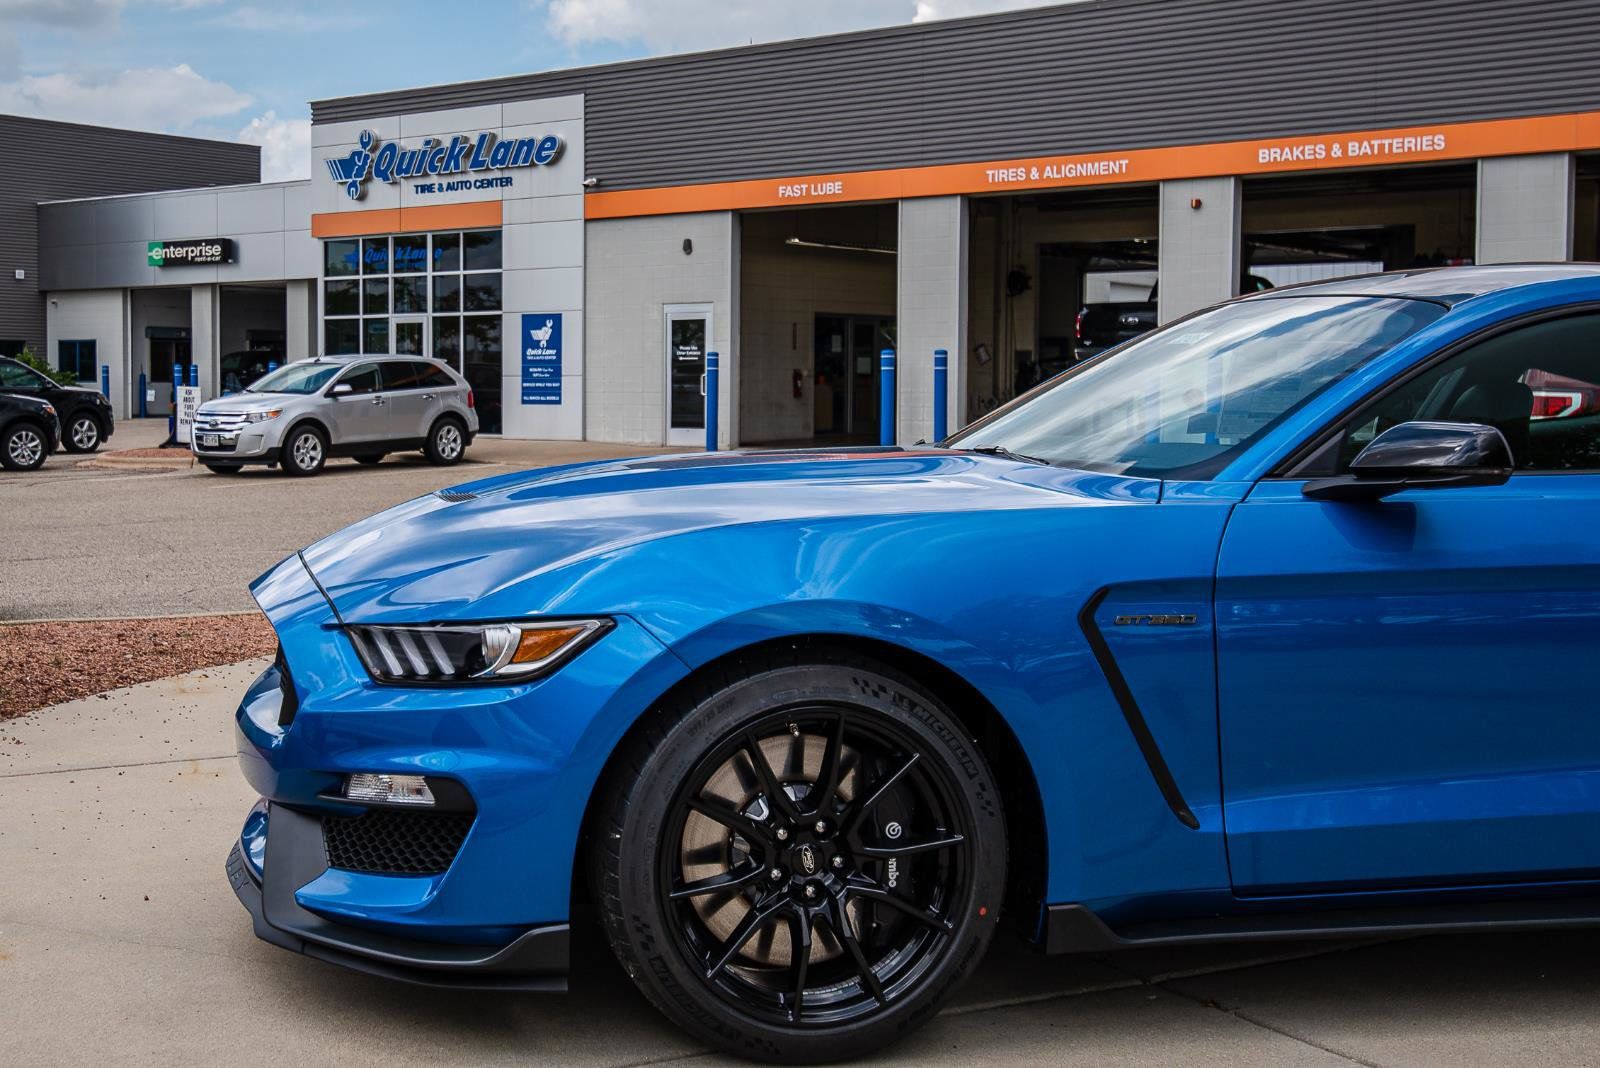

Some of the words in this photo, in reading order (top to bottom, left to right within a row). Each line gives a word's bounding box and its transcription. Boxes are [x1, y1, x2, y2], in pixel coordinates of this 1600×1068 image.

[371, 135, 468, 185] Quick
[468, 132, 561, 171] Lane
[1258, 144, 1326, 164] BRAKES
[1330, 142, 1343, 158] &
[1348, 134, 1446, 157] BATTERIES
[986, 167, 1026, 183] TIRES
[1030, 166, 1040, 180] &
[1043, 159, 1129, 180] ALIGNMENT
[414, 183, 436, 195] TIRE
[437, 182, 444, 193] &
[446, 180, 472, 192] AUTO
[474, 176, 513, 190] CENTER
[778, 184, 808, 198] FAST
[811, 181, 843, 196] LUBE
[150, 242, 221, 261] enterprise
[364, 246, 403, 264] Quik
